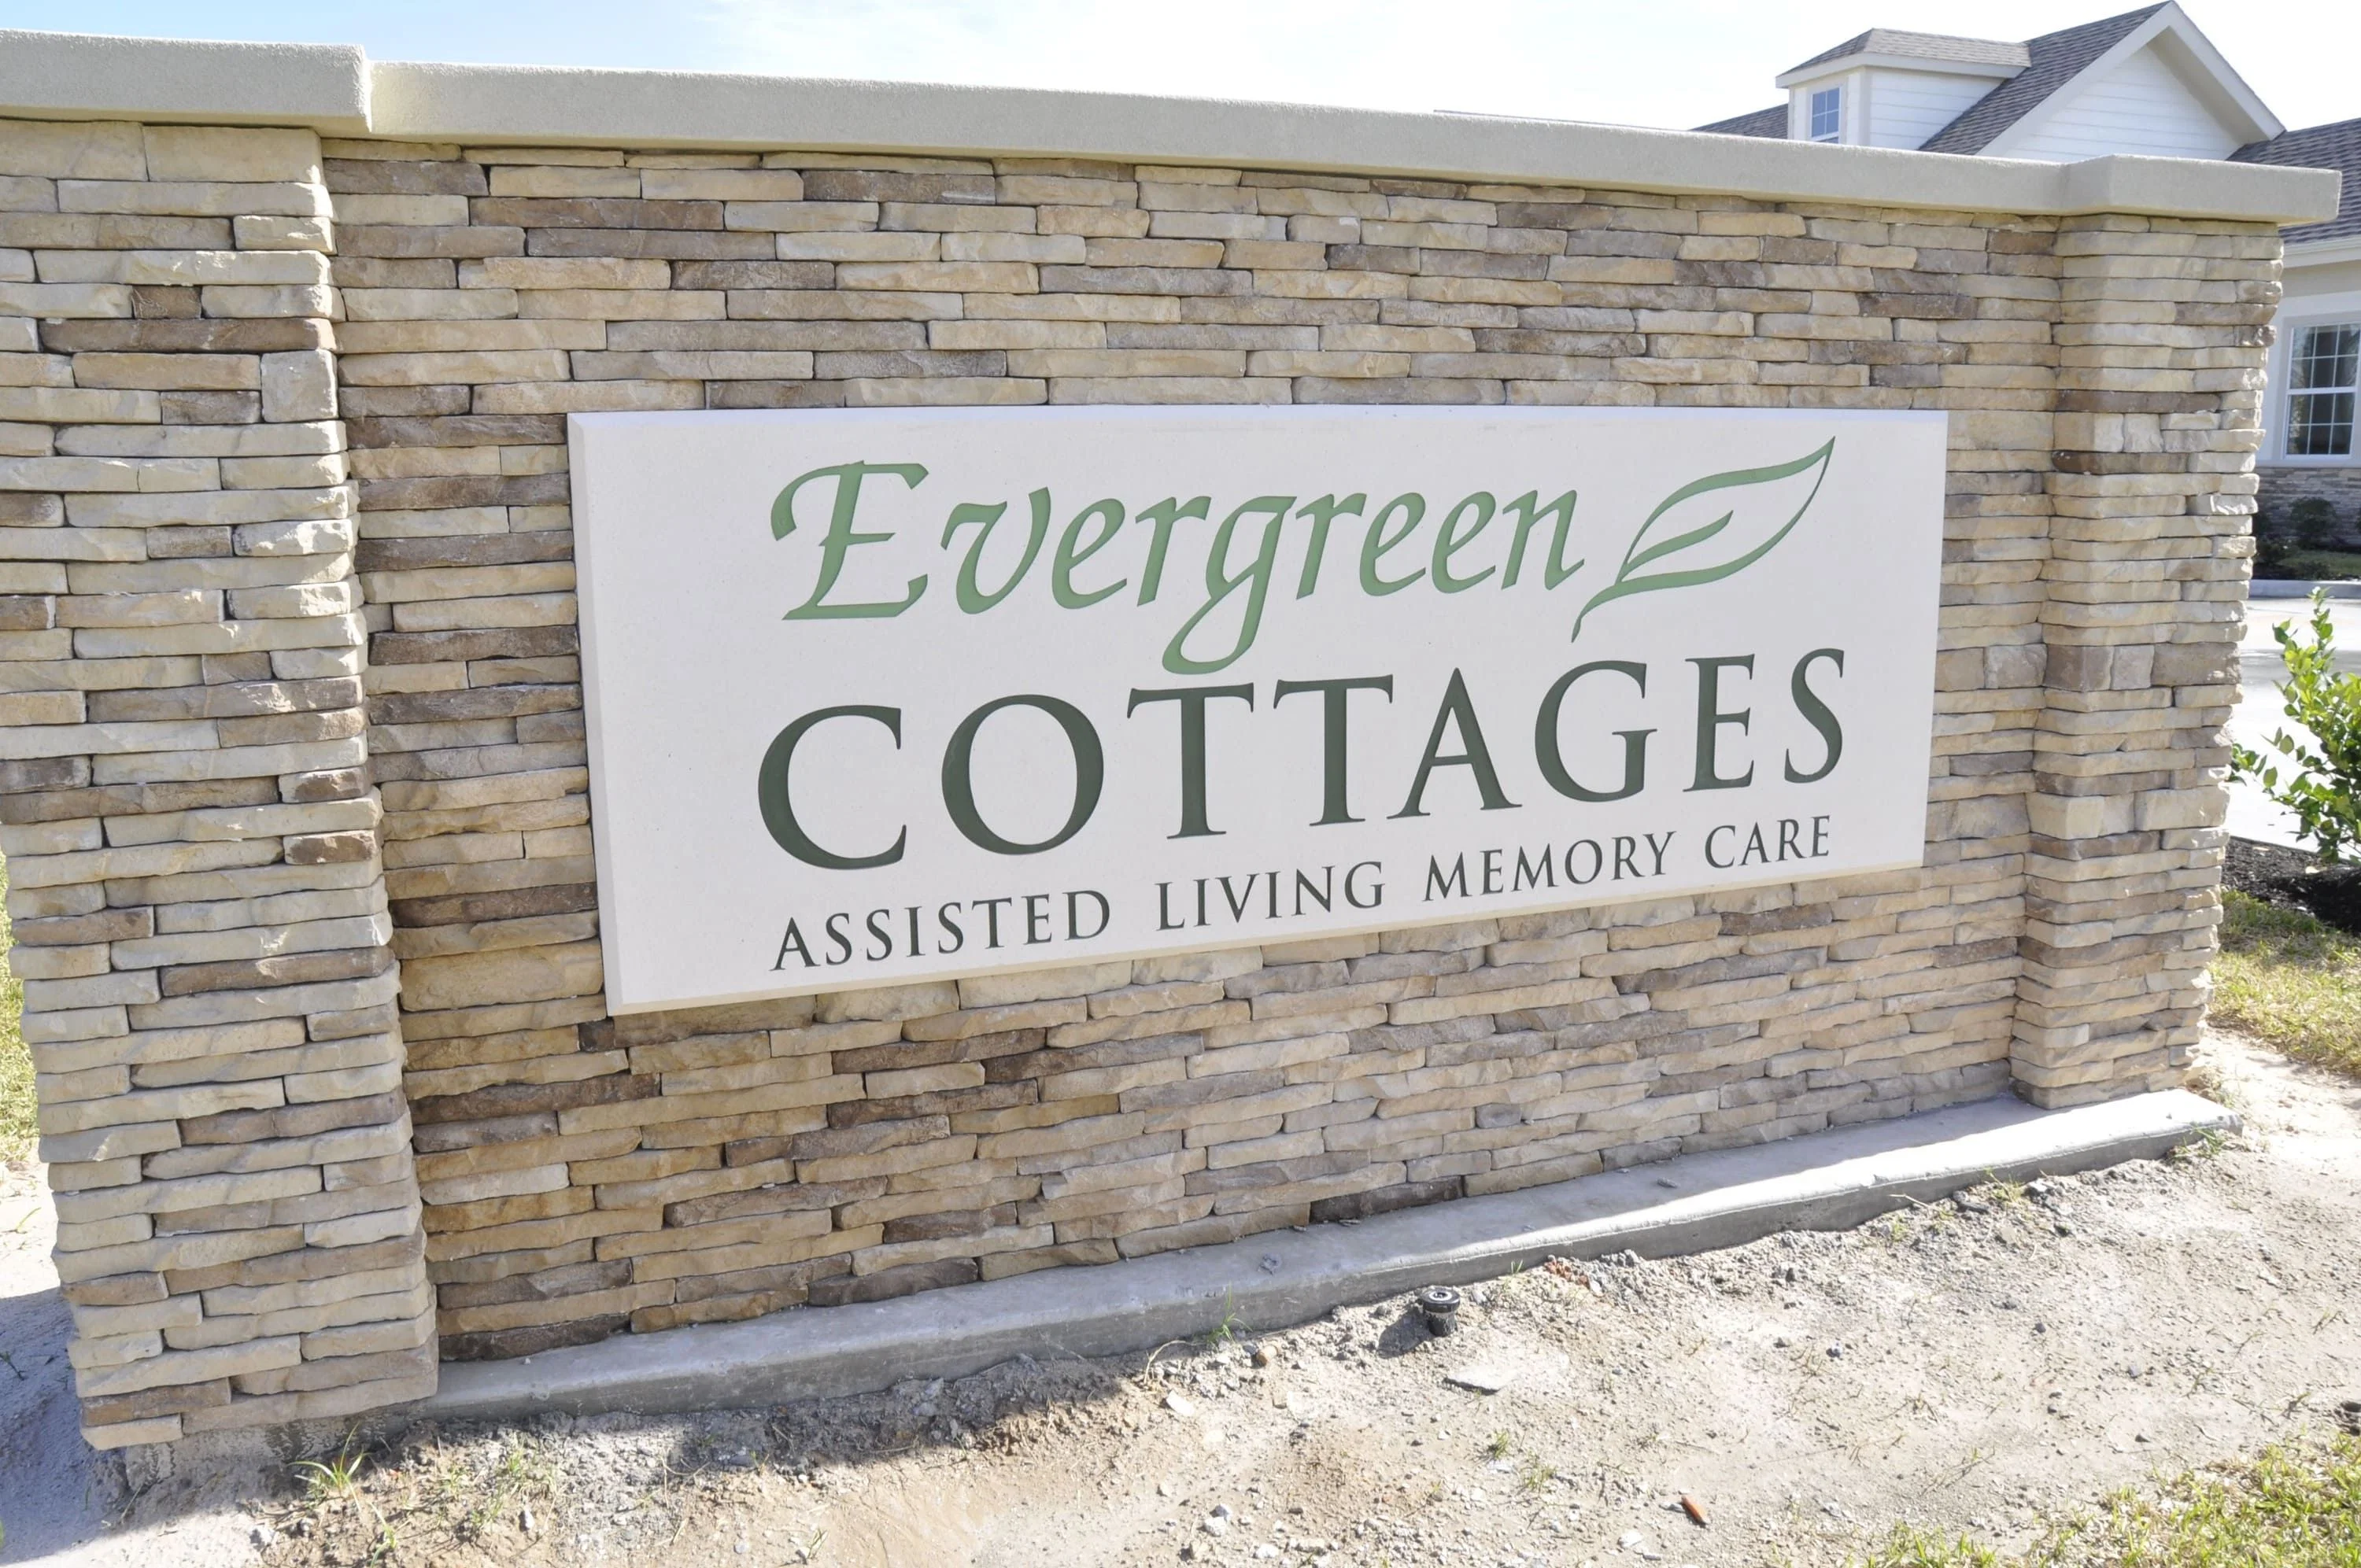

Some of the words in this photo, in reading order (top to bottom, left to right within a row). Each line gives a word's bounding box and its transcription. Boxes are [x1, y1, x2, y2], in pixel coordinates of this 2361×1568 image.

[770, 459, 1584, 676] Evergreen
[757, 647, 1845, 871] COTTAGES
[769, 889, 1111, 972] ASSISTED
[1155, 861, 1387, 932] LIVING
[1422, 830, 1677, 902] MEMORY
[1704, 814, 1831, 869] CARE
